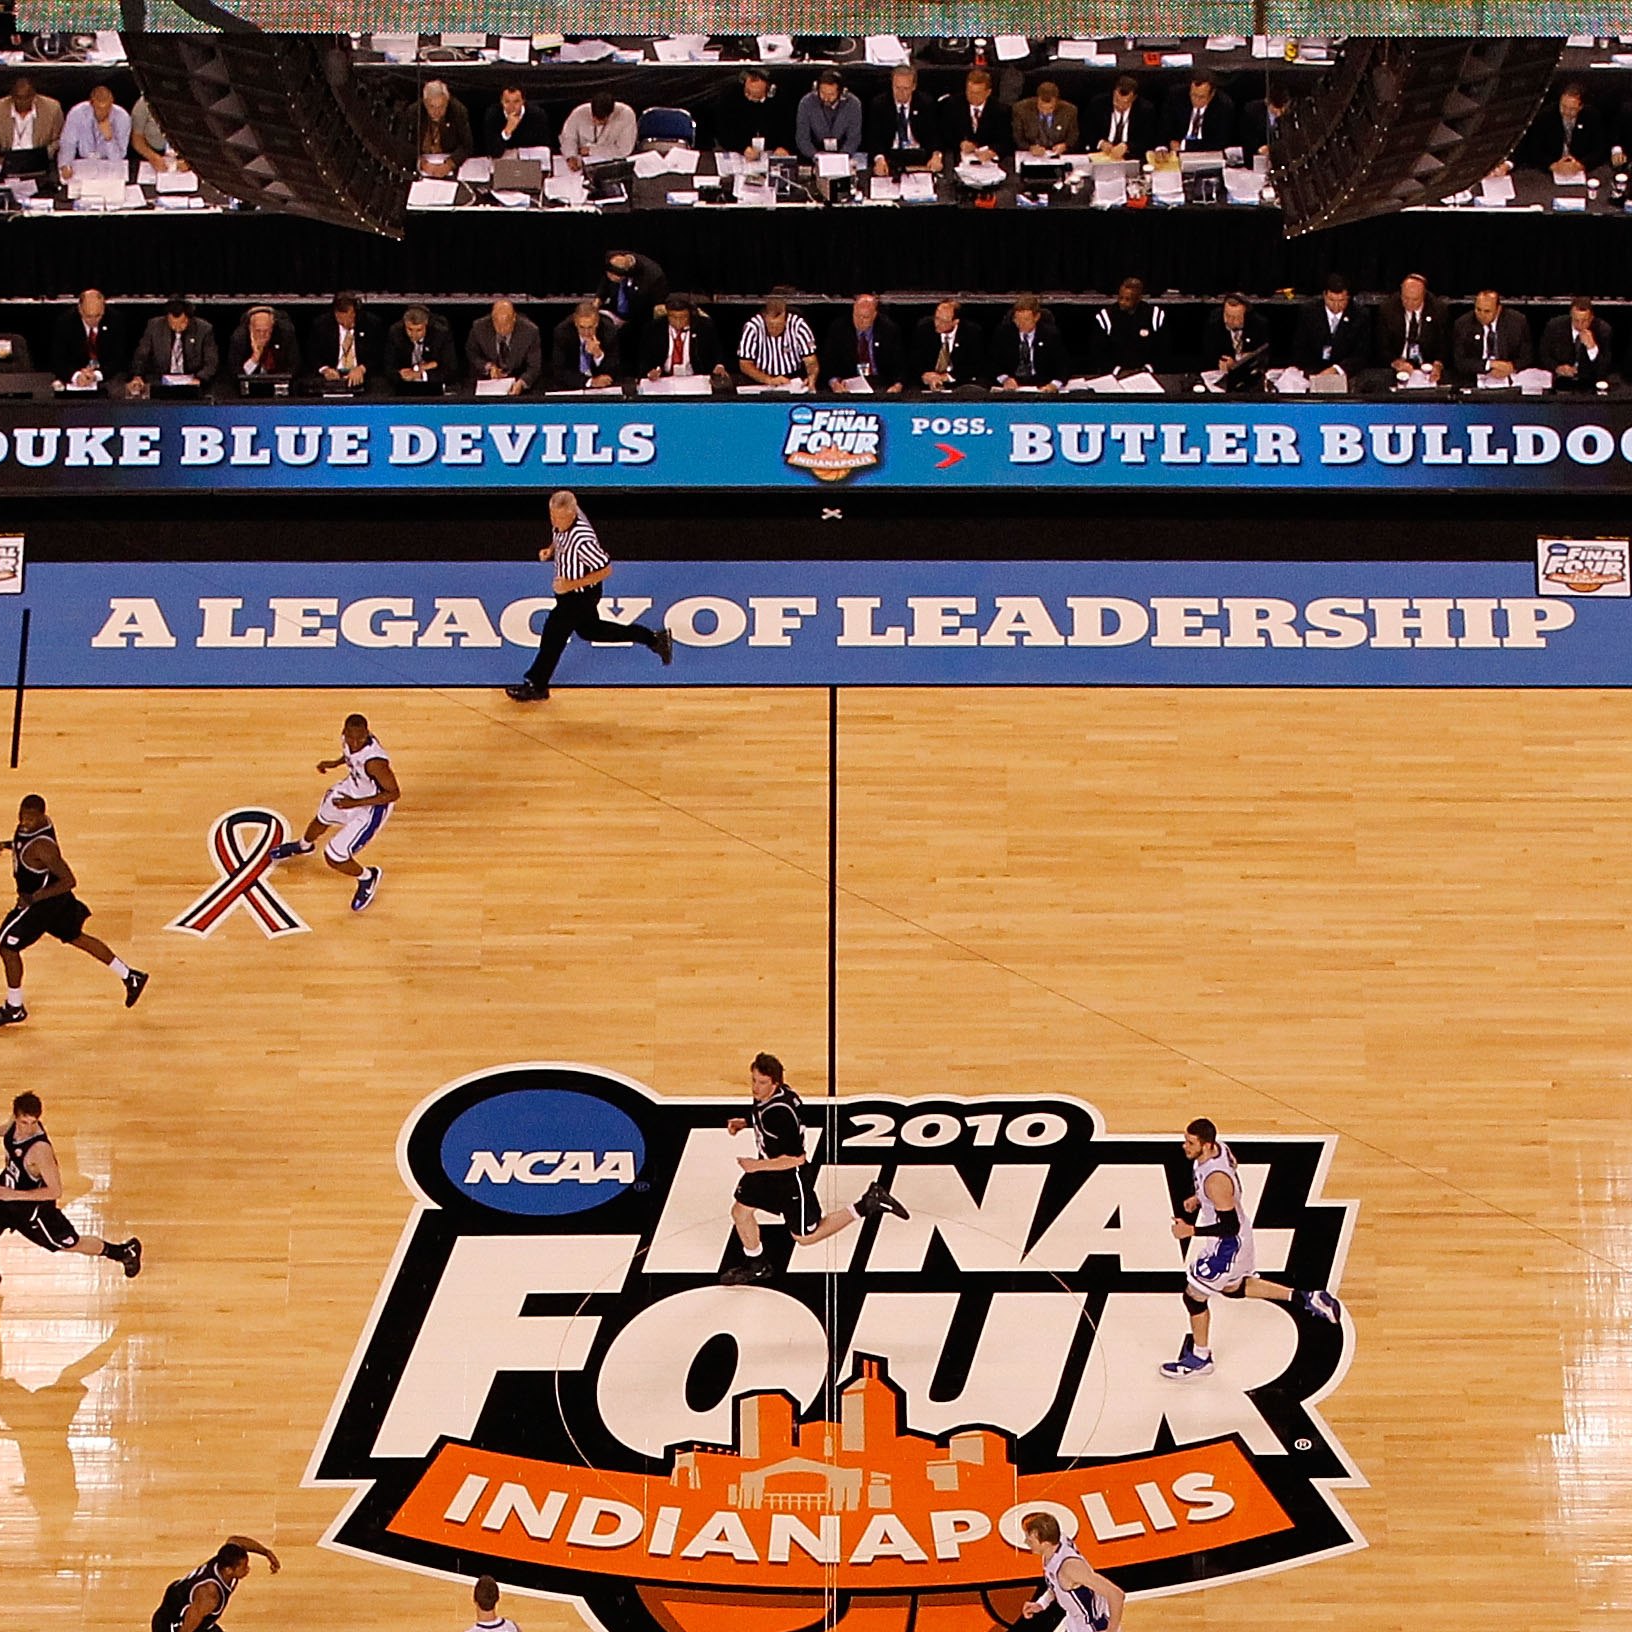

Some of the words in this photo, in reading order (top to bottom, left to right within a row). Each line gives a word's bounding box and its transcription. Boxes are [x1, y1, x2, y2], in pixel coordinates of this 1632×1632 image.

[812, 410, 880, 432] FINAL
[911, 417, 993, 436] POSS.
[181, 426, 369, 466] BLUE
[389, 423, 656, 465] DEVILS
[784, 424, 880, 455] FOUR
[1009, 424, 1300, 465] BUTLER
[1544, 555, 1624, 575] FOUR
[1567, 547, 1624, 561] FINAL
[91, 597, 177, 649] A
[664, 595, 818, 649] OF
[836, 597, 1575, 650] LEADERSHIP
[841, 1112, 1068, 1148] 2010
[463, 1151, 636, 1184] NCAA
[642, 1127, 1296, 1274] FINAL
[369, 1234, 1301, 1458] FOUR
[442, 1472, 1236, 1566] INDIANAPOLIS
